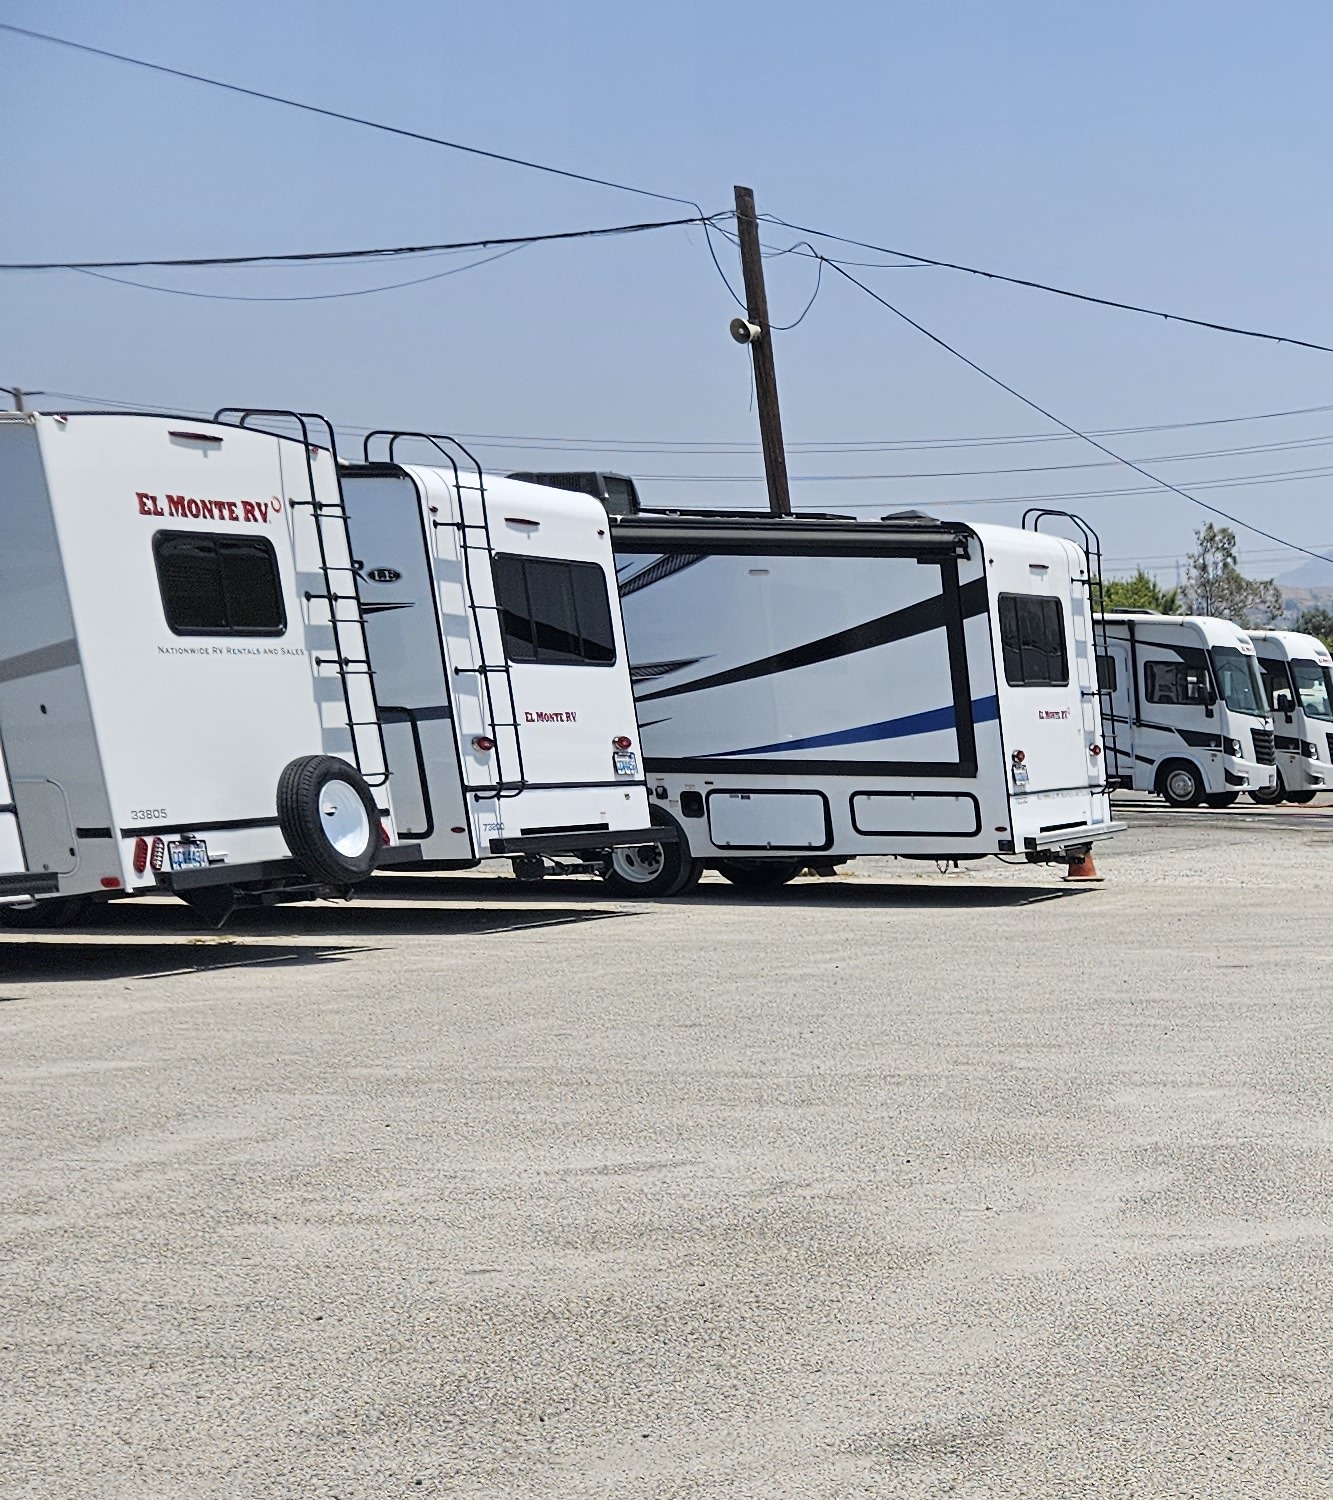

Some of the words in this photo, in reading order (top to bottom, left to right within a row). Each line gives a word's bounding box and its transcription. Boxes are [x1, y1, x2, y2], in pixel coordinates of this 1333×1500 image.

[135, 492, 164, 517] EL
[165, 494, 240, 522] MONTE
[240, 500, 269, 524] RV
[212, 646, 223, 655] RV
[131, 808, 167, 820] 33805
